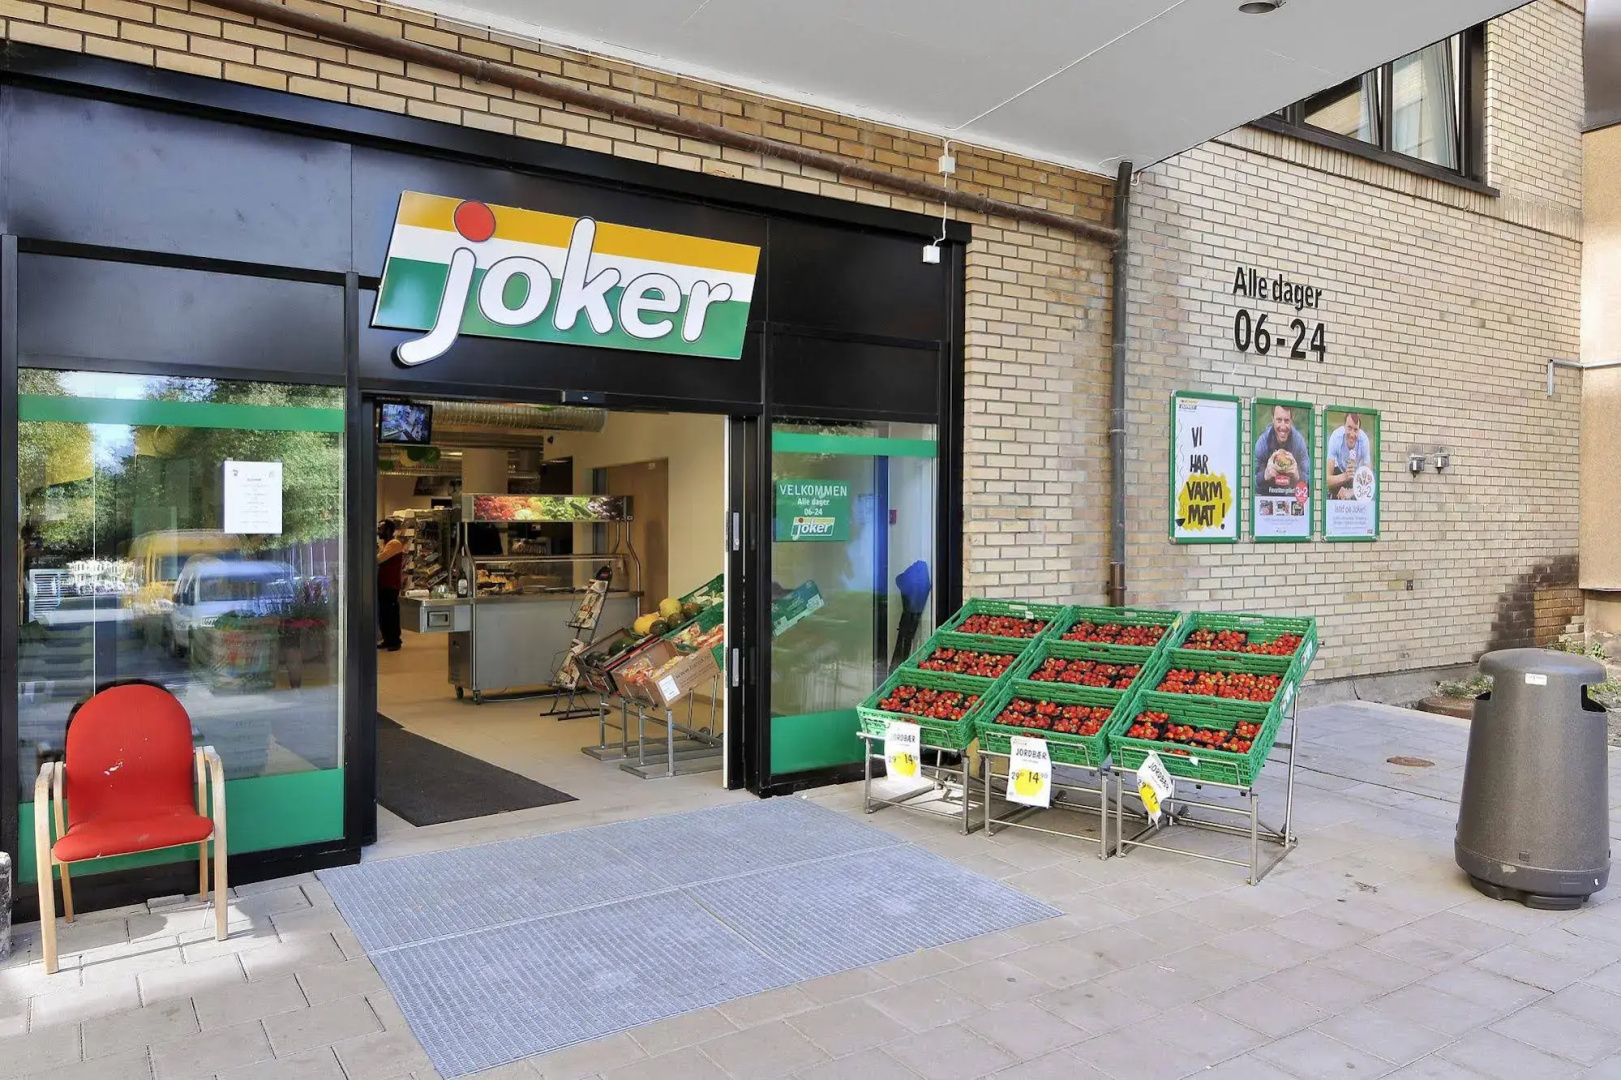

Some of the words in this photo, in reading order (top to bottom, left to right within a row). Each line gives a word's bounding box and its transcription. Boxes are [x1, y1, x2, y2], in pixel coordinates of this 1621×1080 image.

[397, 200, 733, 366] joker
[1233, 266, 1267, 298] Alle
[1272, 273, 1322, 311] dager
[1234, 308, 1326, 363] 06-24
[1191, 426, 1202, 448] VI
[1190, 454, 1209, 475] HAR
[779, 484, 847, 497] VELKOMMEN
[1186, 481, 1223, 502] VARM
[804, 508, 823, 516] 06-24
[811, 498, 830, 506] dager
[792, 517, 831, 541] joker
[1015, 748, 1047, 760] JORDBÆR
